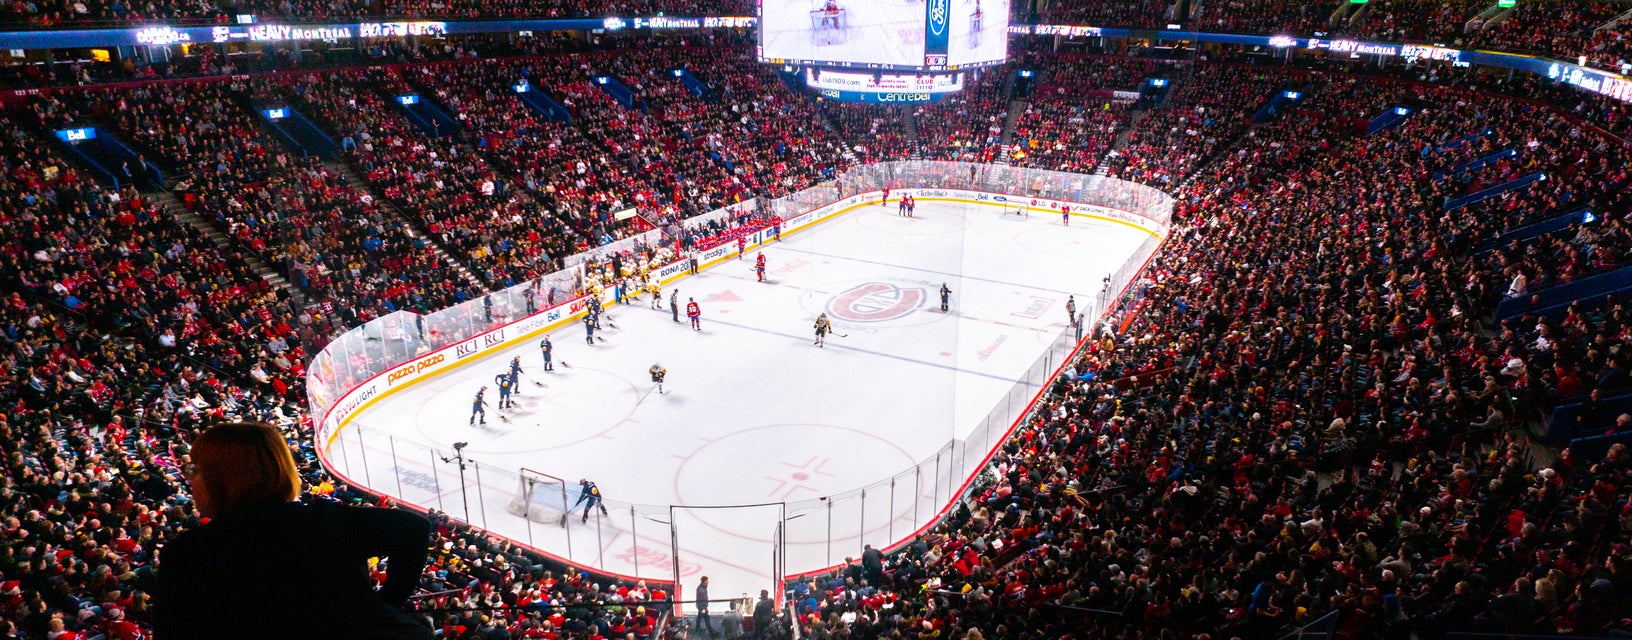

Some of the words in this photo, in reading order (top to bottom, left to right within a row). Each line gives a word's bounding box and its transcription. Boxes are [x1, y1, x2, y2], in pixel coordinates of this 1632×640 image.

[249, 25, 290, 40] HEAVY
[269, 109, 284, 118] Bell
[67, 129, 86, 140] Bell
[660, 265, 679, 277] RONA
[569, 298, 587, 315] SKIP
[547, 309, 560, 322] Bell
[456, 339, 478, 357] RCI
[484, 329, 505, 346] RCI
[388, 365, 415, 386] pizza
[417, 354, 444, 374] pizza
[356, 385, 377, 405] LIGHT
